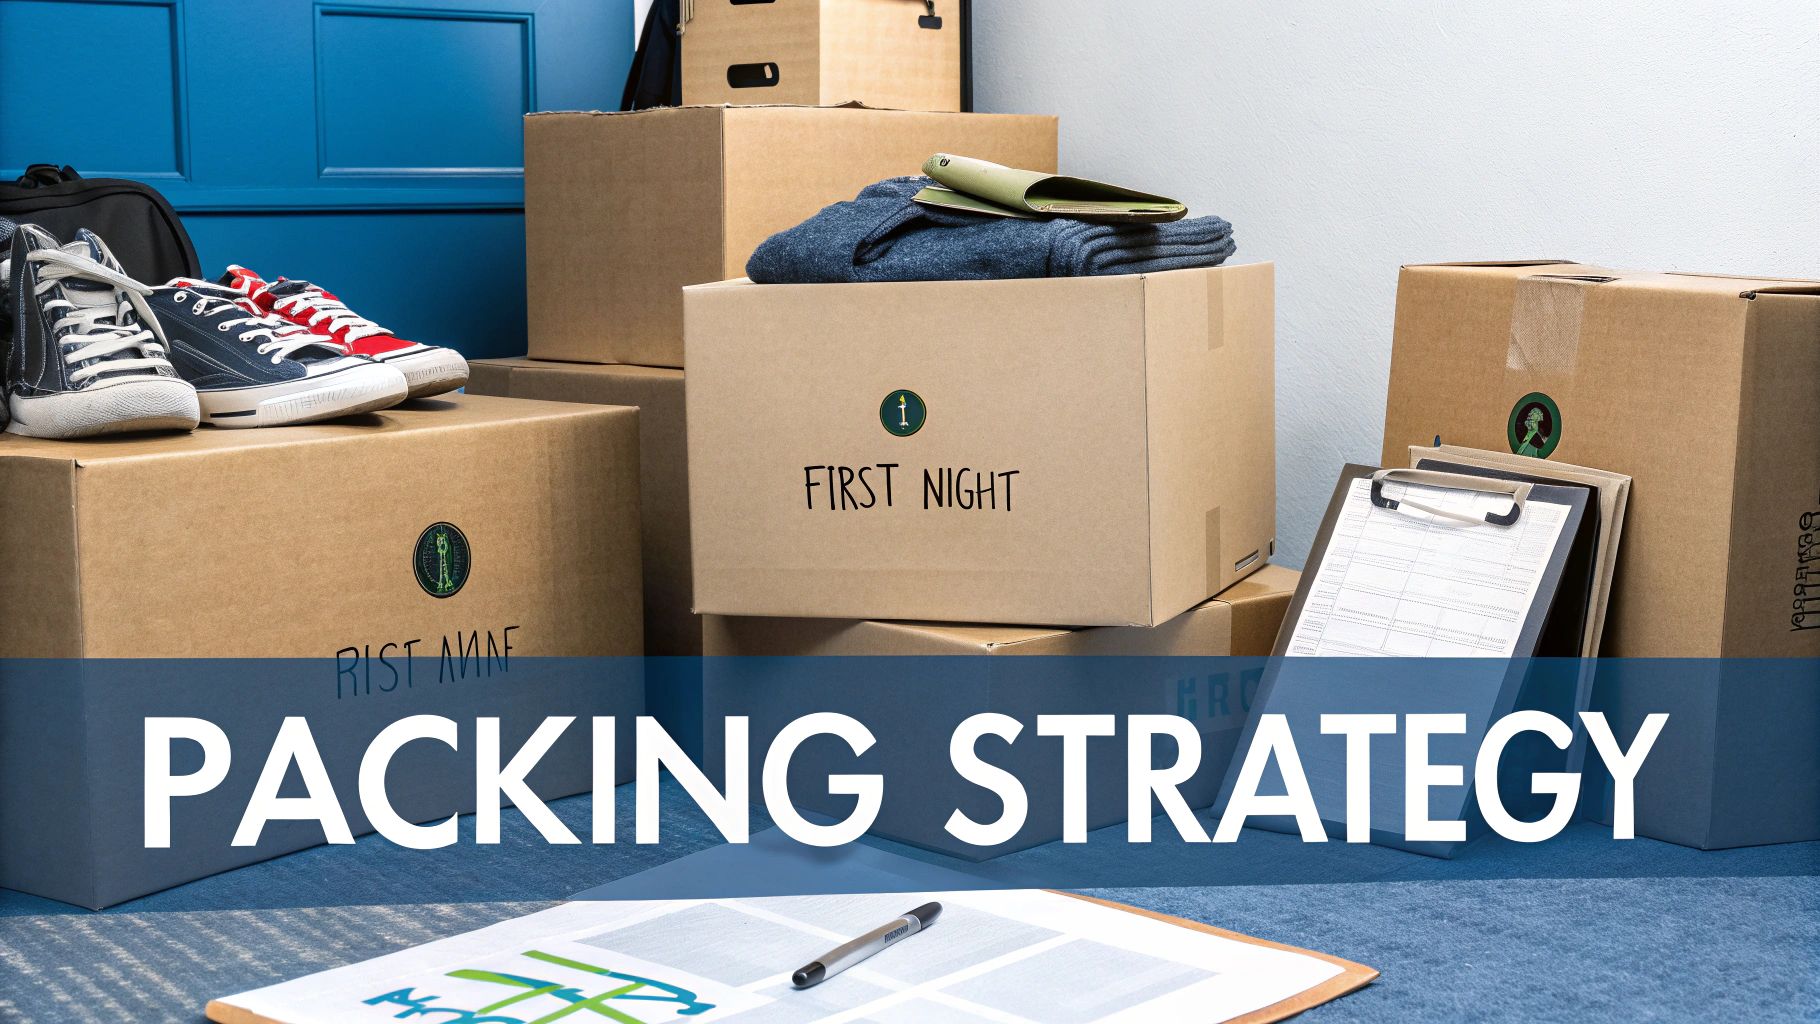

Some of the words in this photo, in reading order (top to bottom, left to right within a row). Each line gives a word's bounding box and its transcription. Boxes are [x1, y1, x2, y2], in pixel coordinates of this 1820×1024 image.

[803, 463, 899, 511] FIRST
[923, 467, 1020, 512] NIGHT
[336, 639, 422, 700] RIST
